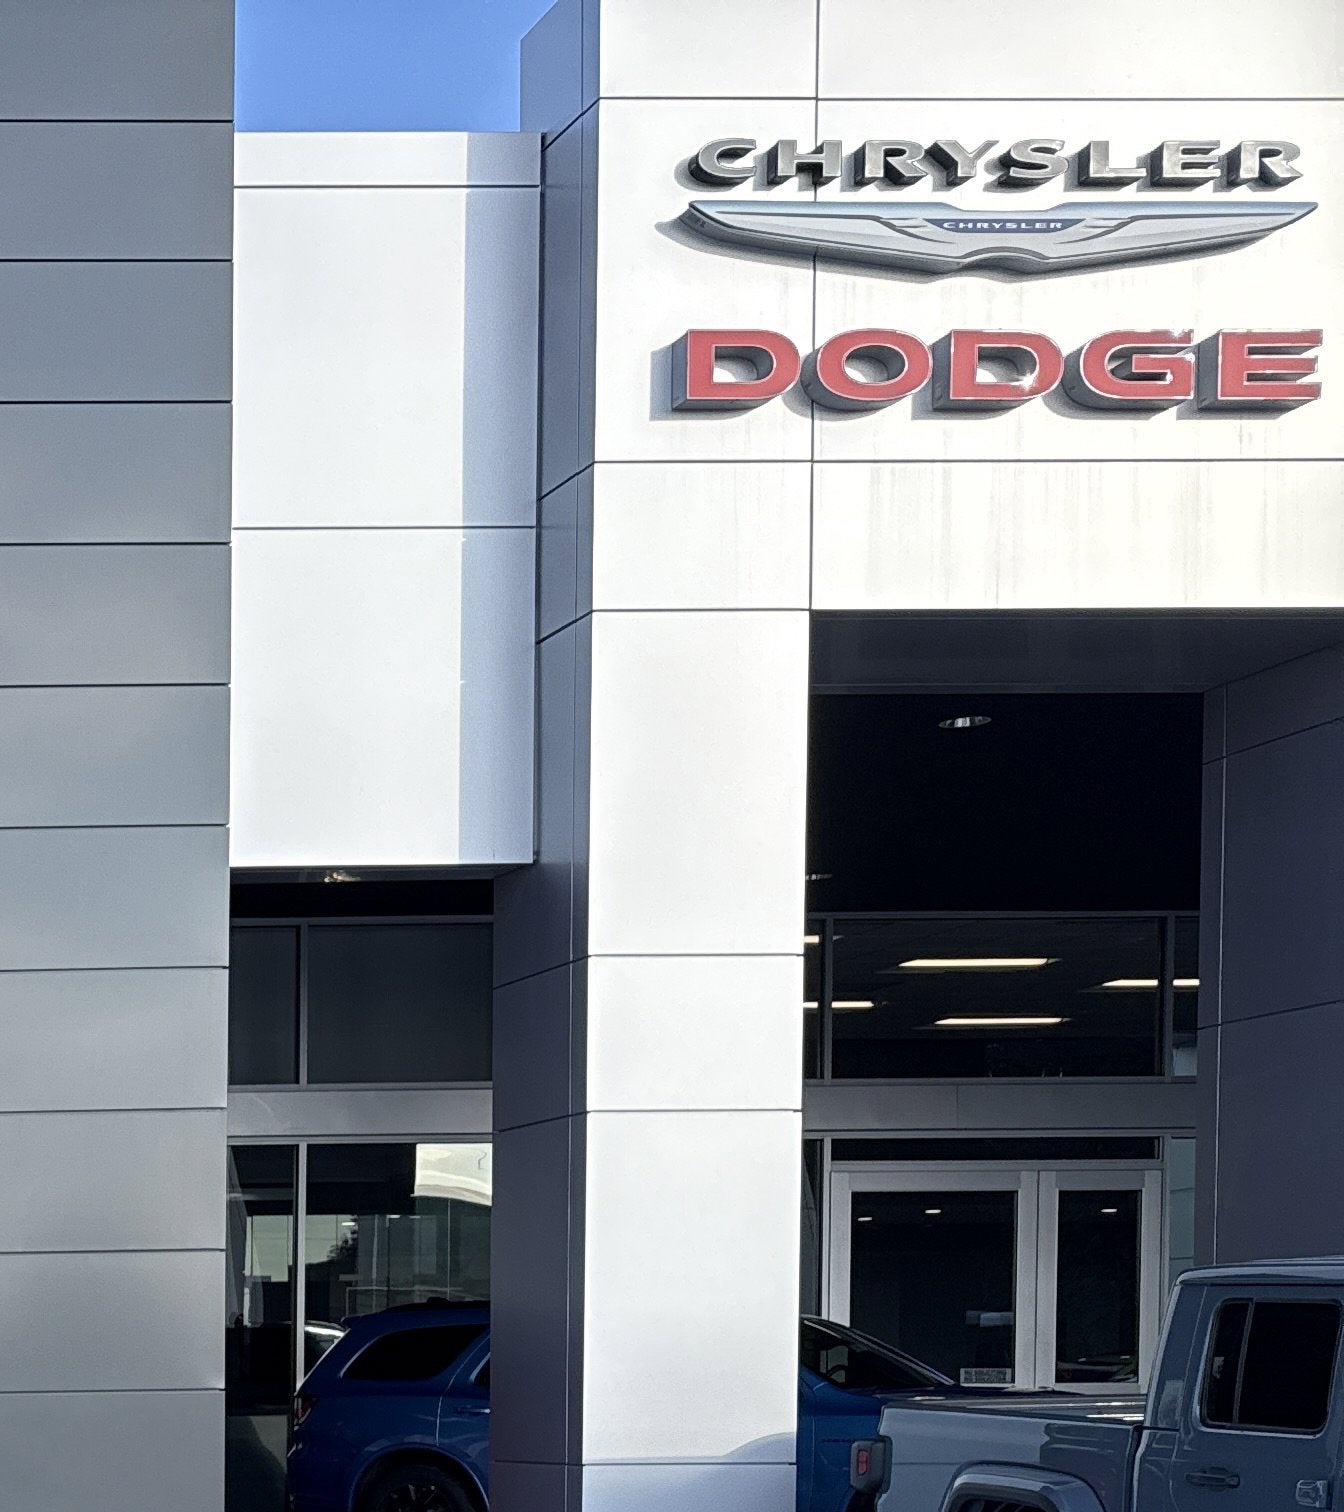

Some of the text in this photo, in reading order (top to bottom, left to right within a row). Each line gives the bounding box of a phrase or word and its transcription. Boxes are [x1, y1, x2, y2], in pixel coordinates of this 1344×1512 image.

[688, 137, 1303, 184] CHRYSLER
[941, 220, 1064, 230] CHRYSLER
[680, 328, 1324, 408] DODGE
